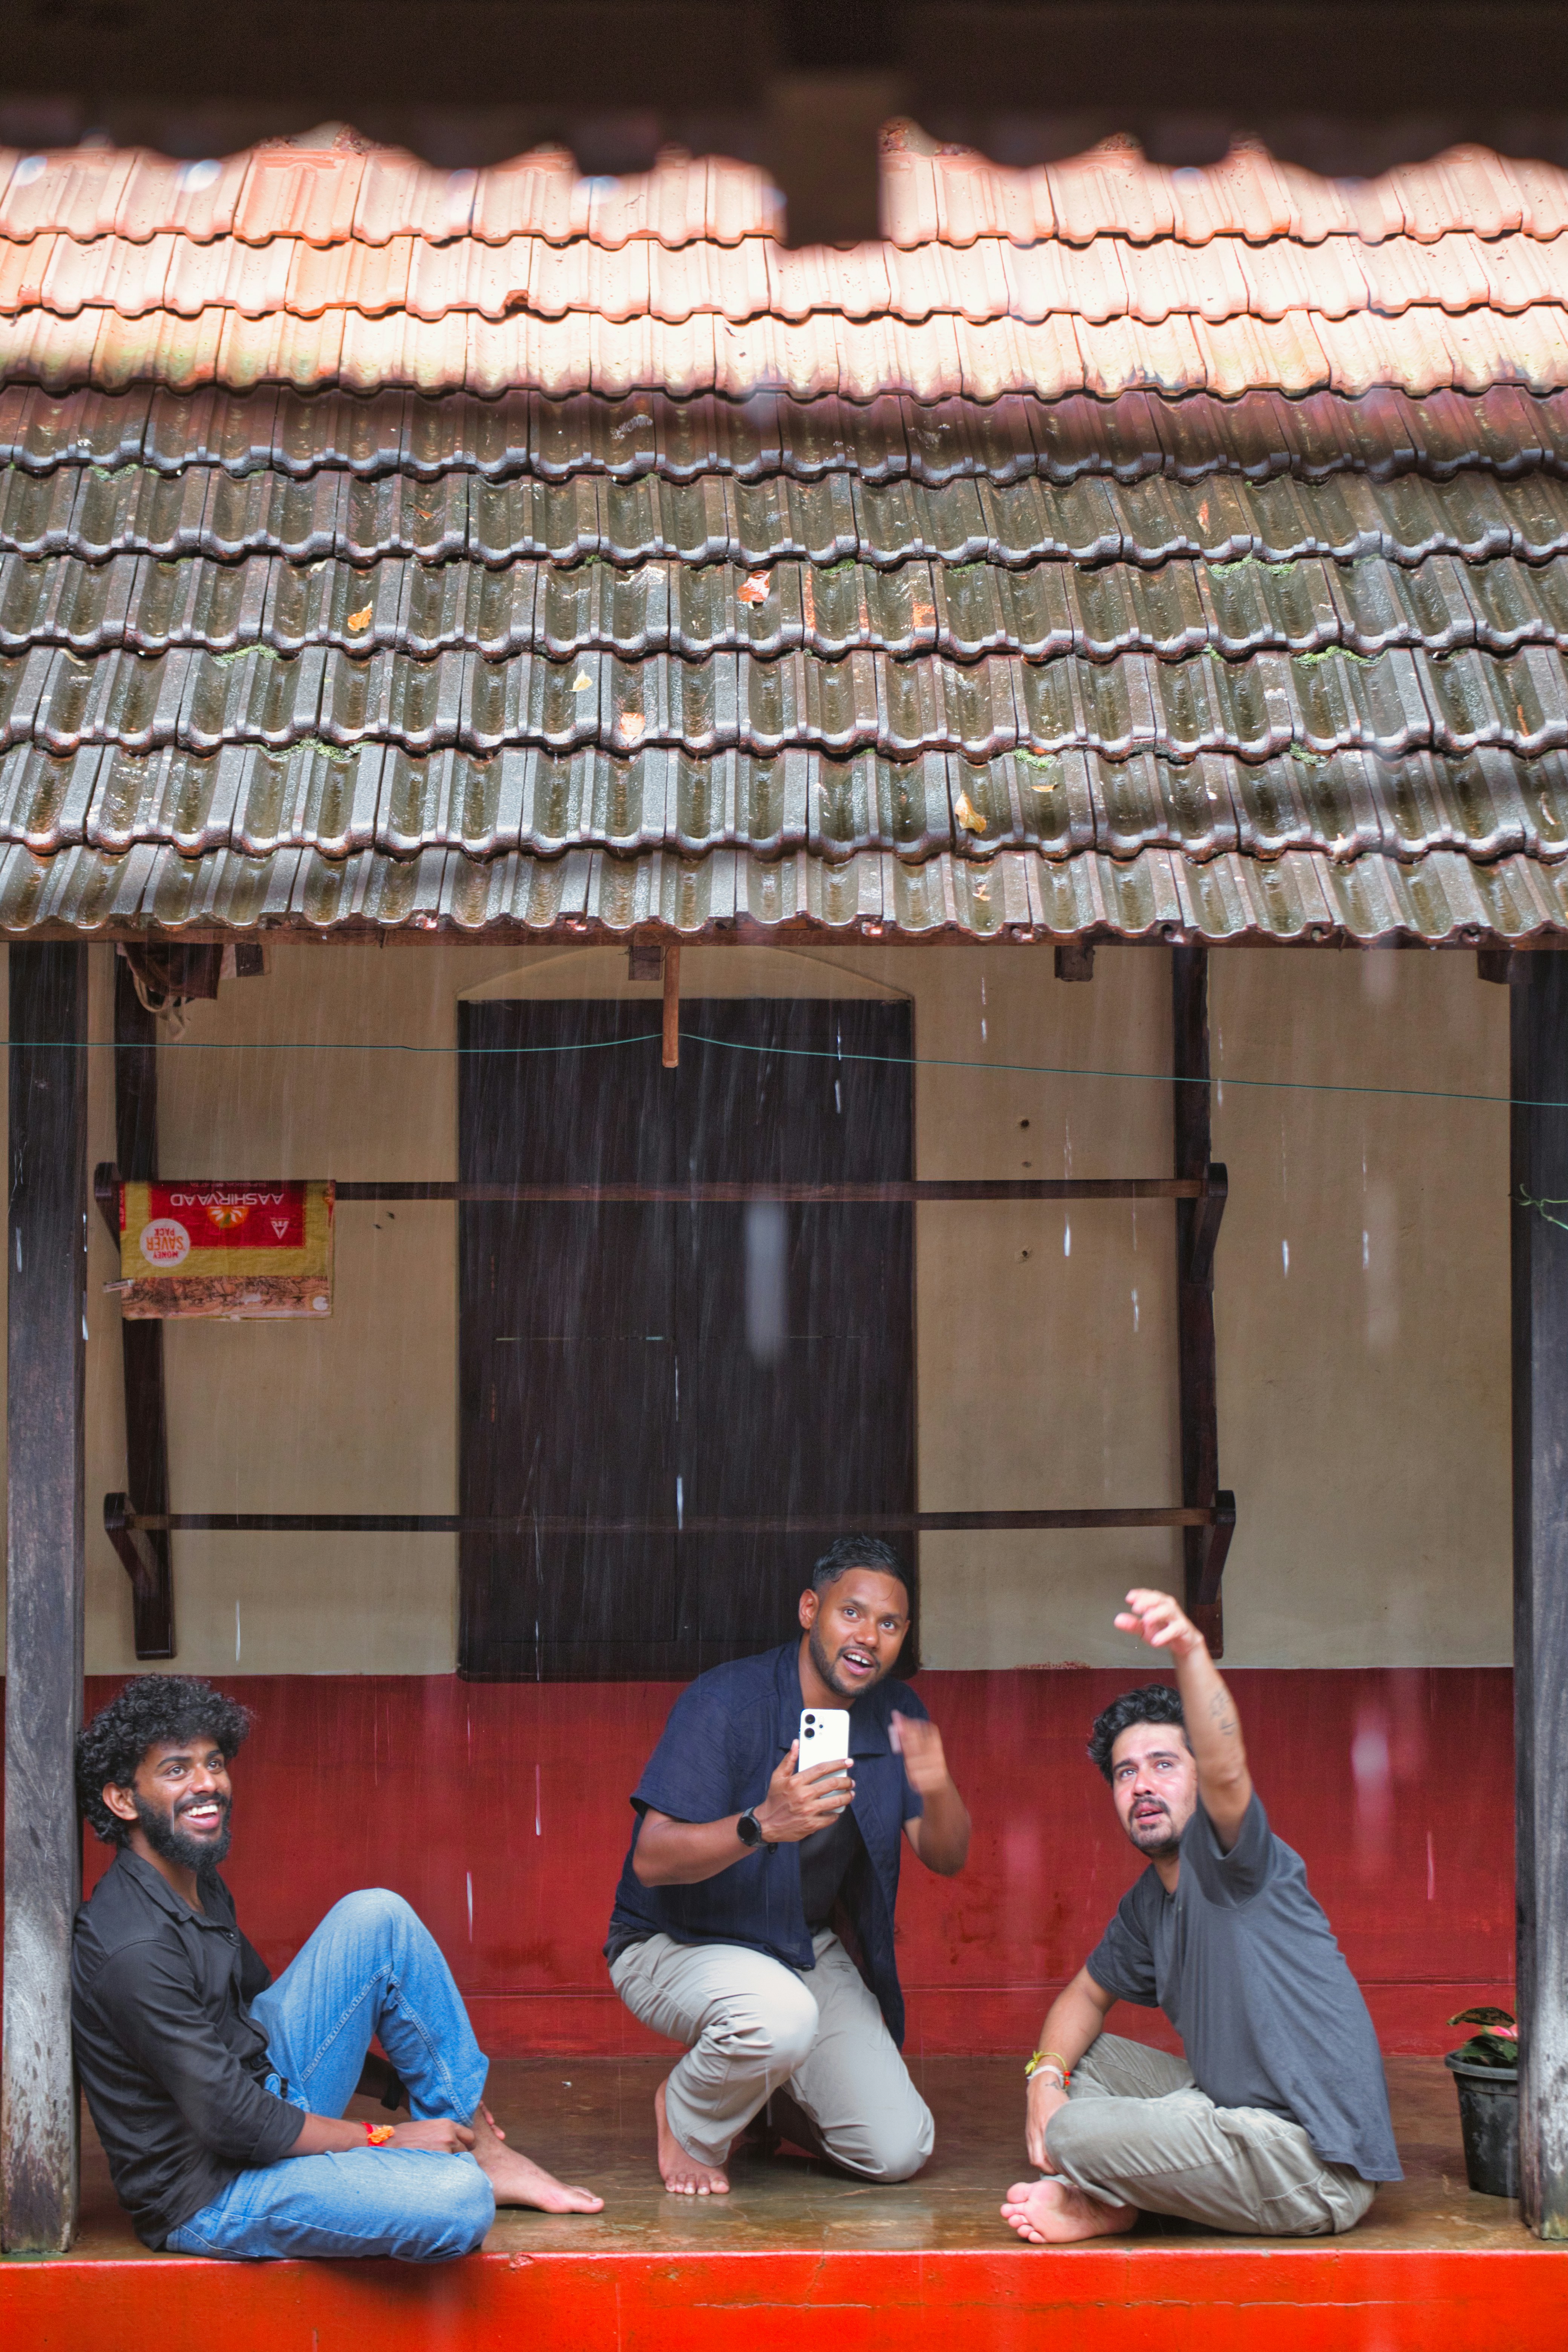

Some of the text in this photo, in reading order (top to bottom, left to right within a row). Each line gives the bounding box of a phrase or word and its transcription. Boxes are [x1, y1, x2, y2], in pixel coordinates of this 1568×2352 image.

[170, 1191, 284, 1206] AASHIRVAAD
[146, 1236, 184, 1251] SAVER
[153, 1251, 178, 1259] MONEY
